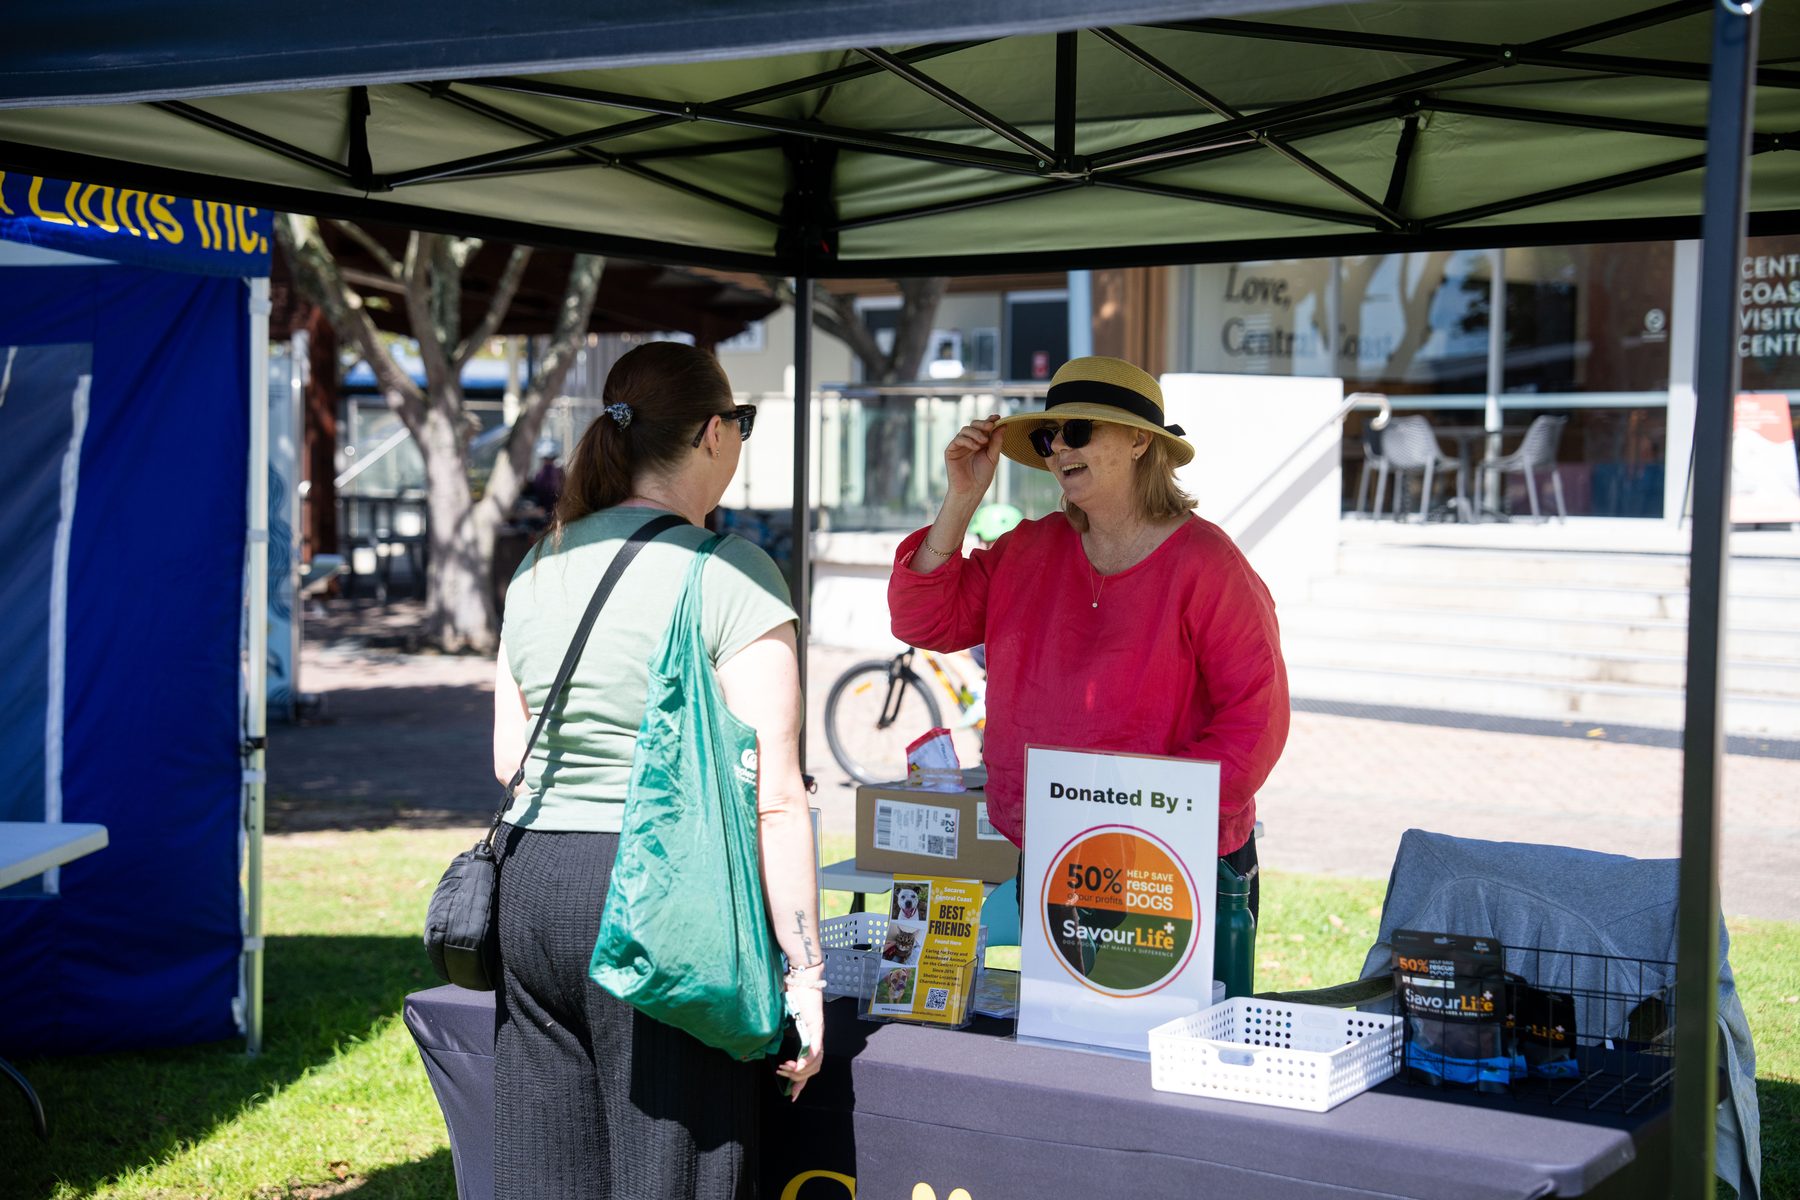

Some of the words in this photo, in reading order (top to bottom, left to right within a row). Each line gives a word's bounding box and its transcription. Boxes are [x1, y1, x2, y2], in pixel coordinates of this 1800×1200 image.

[1738, 333, 1800, 358] CENT
[1050, 782, 1142, 807] Donated
[1151, 792, 1179, 814] By
[1067, 863, 1122, 894] 50%
[1127, 869, 1149, 879] HELP
[1151, 872, 1174, 882] SAVE
[1126, 880, 1174, 895] rescue
[1095, 895, 1123, 906] profits
[1126, 893, 1174, 911] DOGS
[939, 904, 966, 920] BEST
[928, 920, 972, 938] FRIENDS
[1063, 919, 1174, 950] SavourLife
[1398, 956, 1429, 974] 50%
